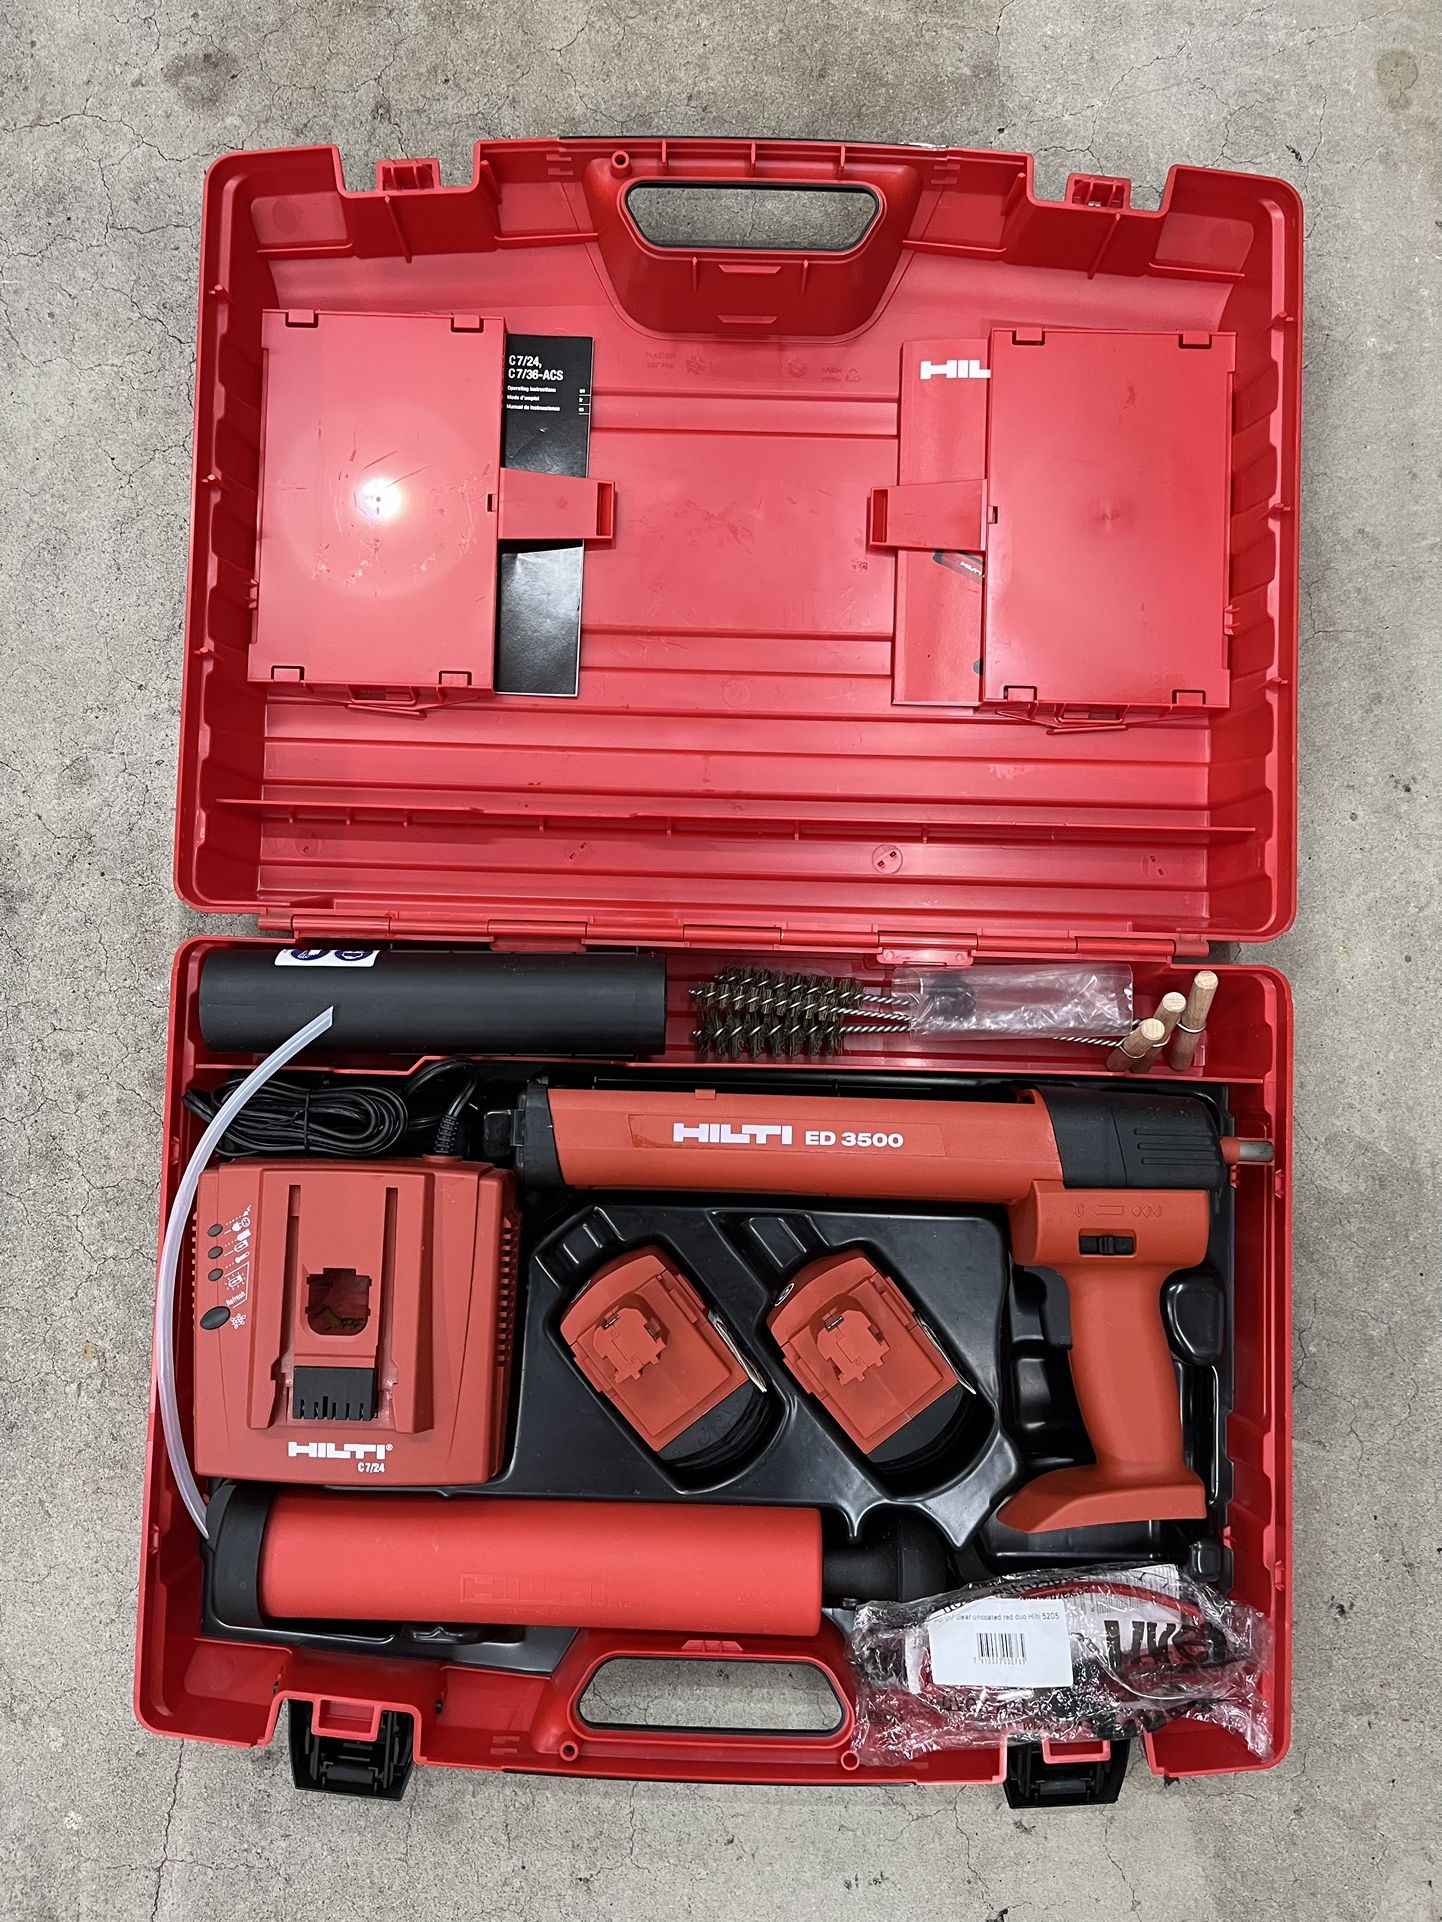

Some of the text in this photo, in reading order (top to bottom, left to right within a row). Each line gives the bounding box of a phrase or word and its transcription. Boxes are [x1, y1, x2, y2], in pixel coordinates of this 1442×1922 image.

[507, 385, 530, 393] Operating
[673, 1122, 904, 1148] HILTI ED 3500
[226, 1291, 246, 1306] Refresh
[973, 1613, 1002, 1621] uncoated
[1003, 1613, 1014, 1621] red
[1042, 1612, 1060, 1620] 5205
